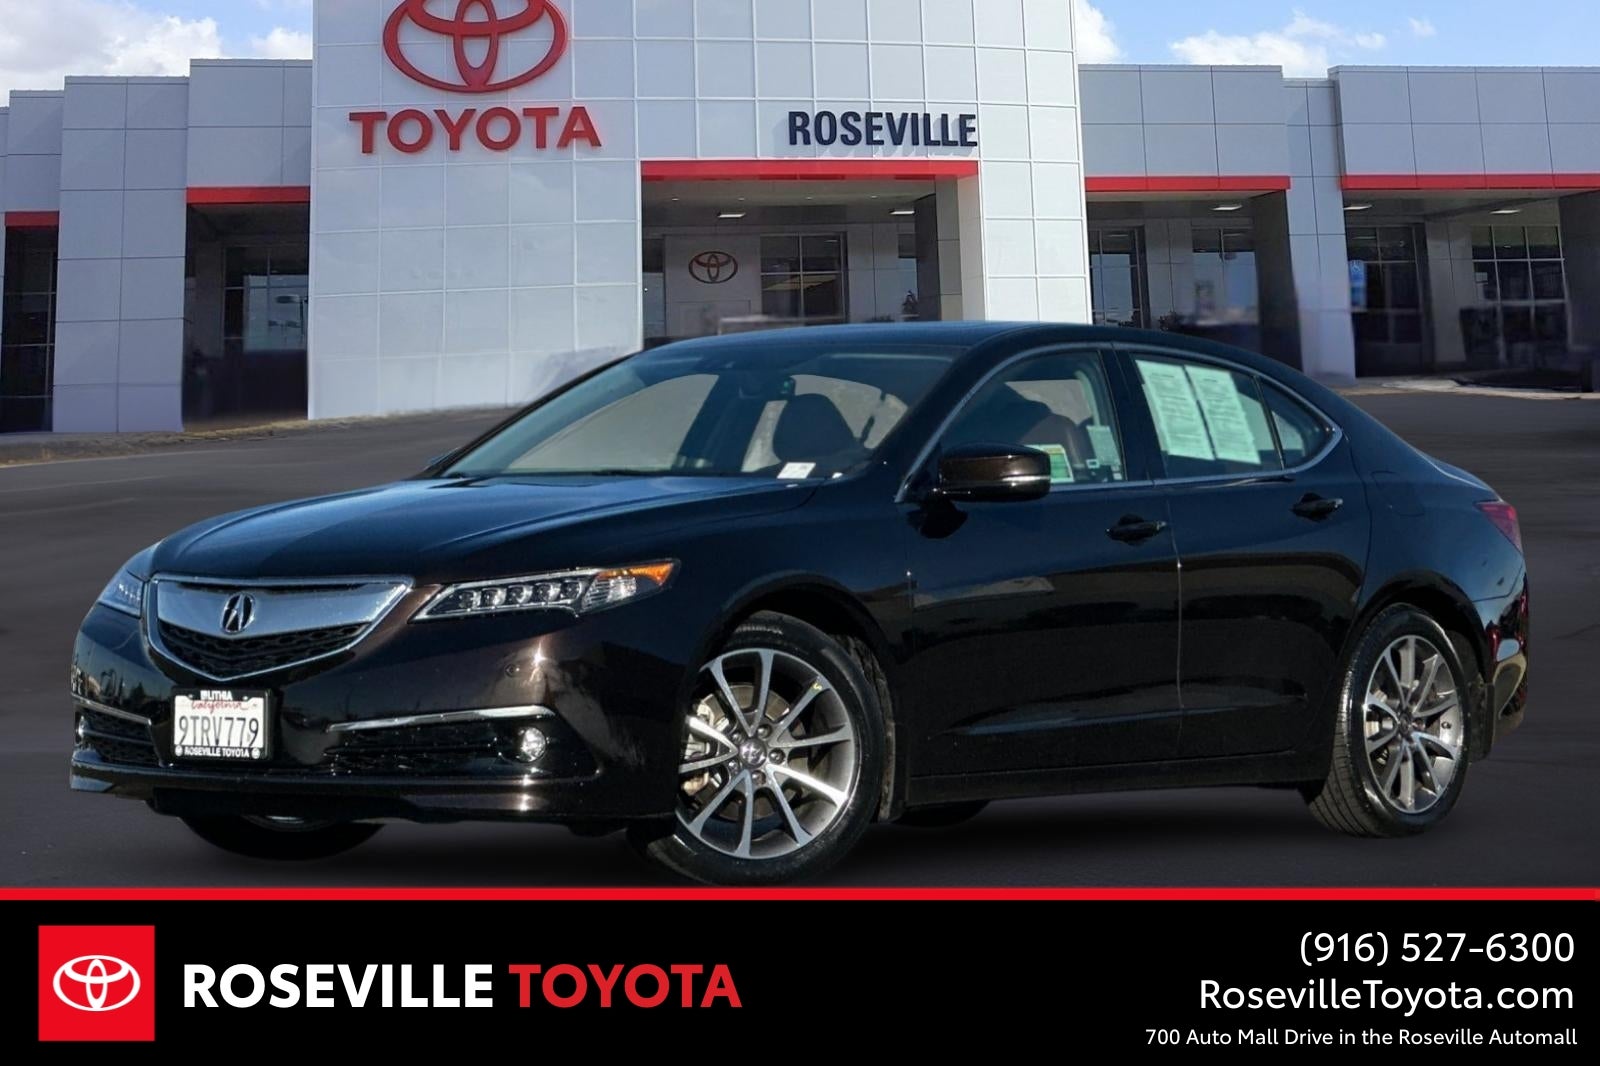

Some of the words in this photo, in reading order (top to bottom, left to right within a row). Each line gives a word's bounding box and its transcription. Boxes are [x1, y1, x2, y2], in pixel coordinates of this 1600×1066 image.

[350, 107, 601, 154] TOYOTA
[788, 110, 978, 148] ROSEVILLE
[179, 715, 259, 748] 9TRV779
[184, 746, 221, 757] ROSEVILLE
[222, 747, 250, 758] TOYOTA
